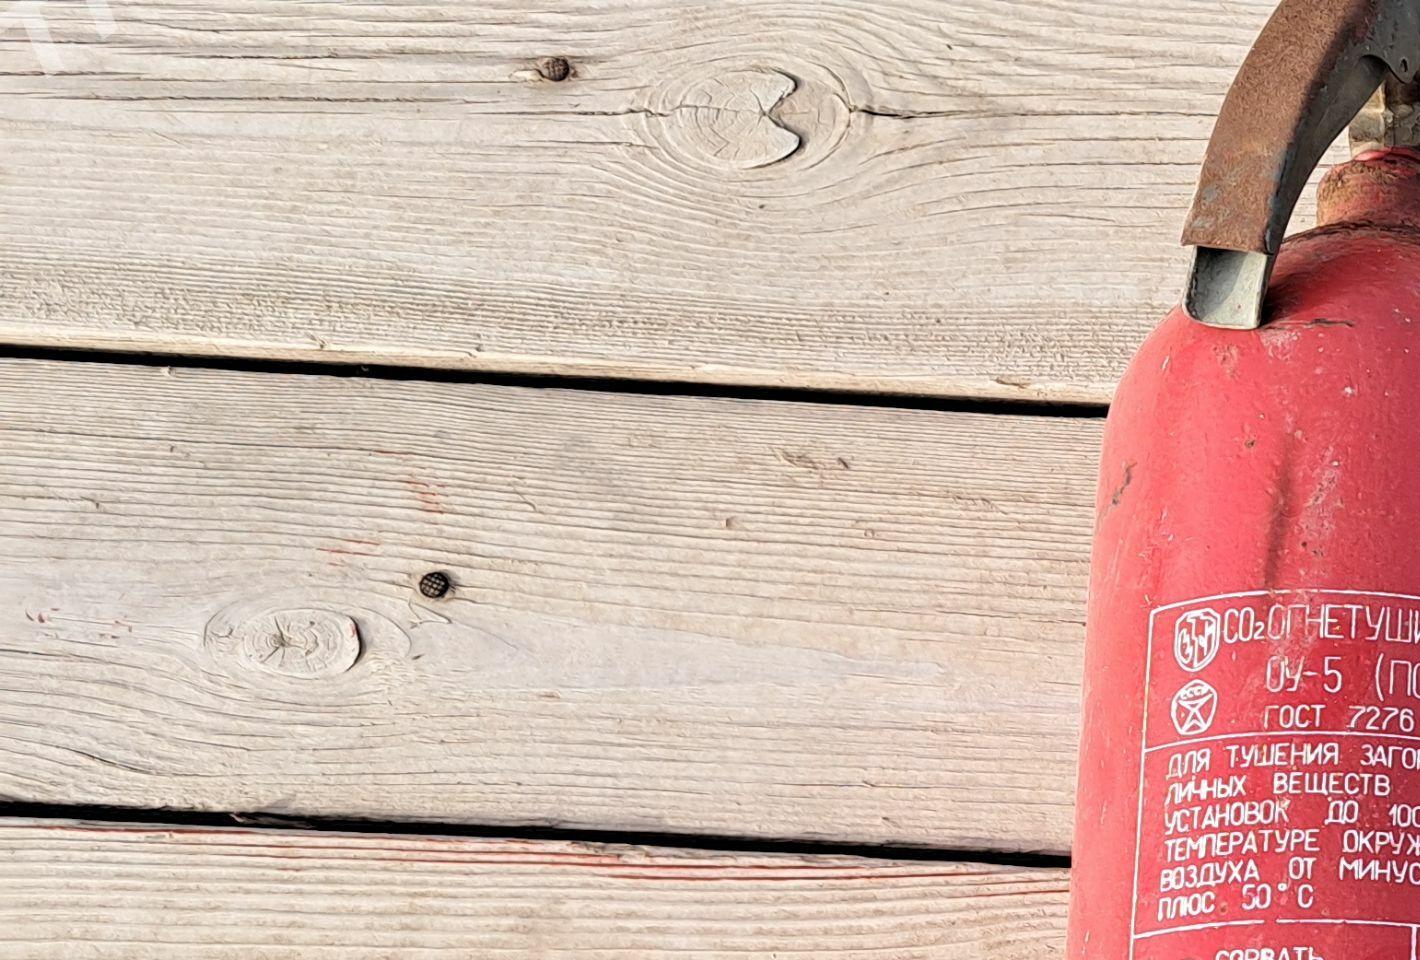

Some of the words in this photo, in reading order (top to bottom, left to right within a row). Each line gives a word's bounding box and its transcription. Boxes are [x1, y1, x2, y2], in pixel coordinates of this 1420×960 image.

[1263, 705, 1326, 730] ГОСТ
[1274, 773, 1391, 796] ВЕЩЕСТВ
[1164, 798, 1290, 835] УСТАНОВОК
[1325, 800, 1359, 825] ДО
[1165, 830, 1320, 861] ТЕМПЕРАТУРЕ
[1160, 865, 1259, 892] ВОЗДУХА
[1289, 859, 1314, 879] ОТ
